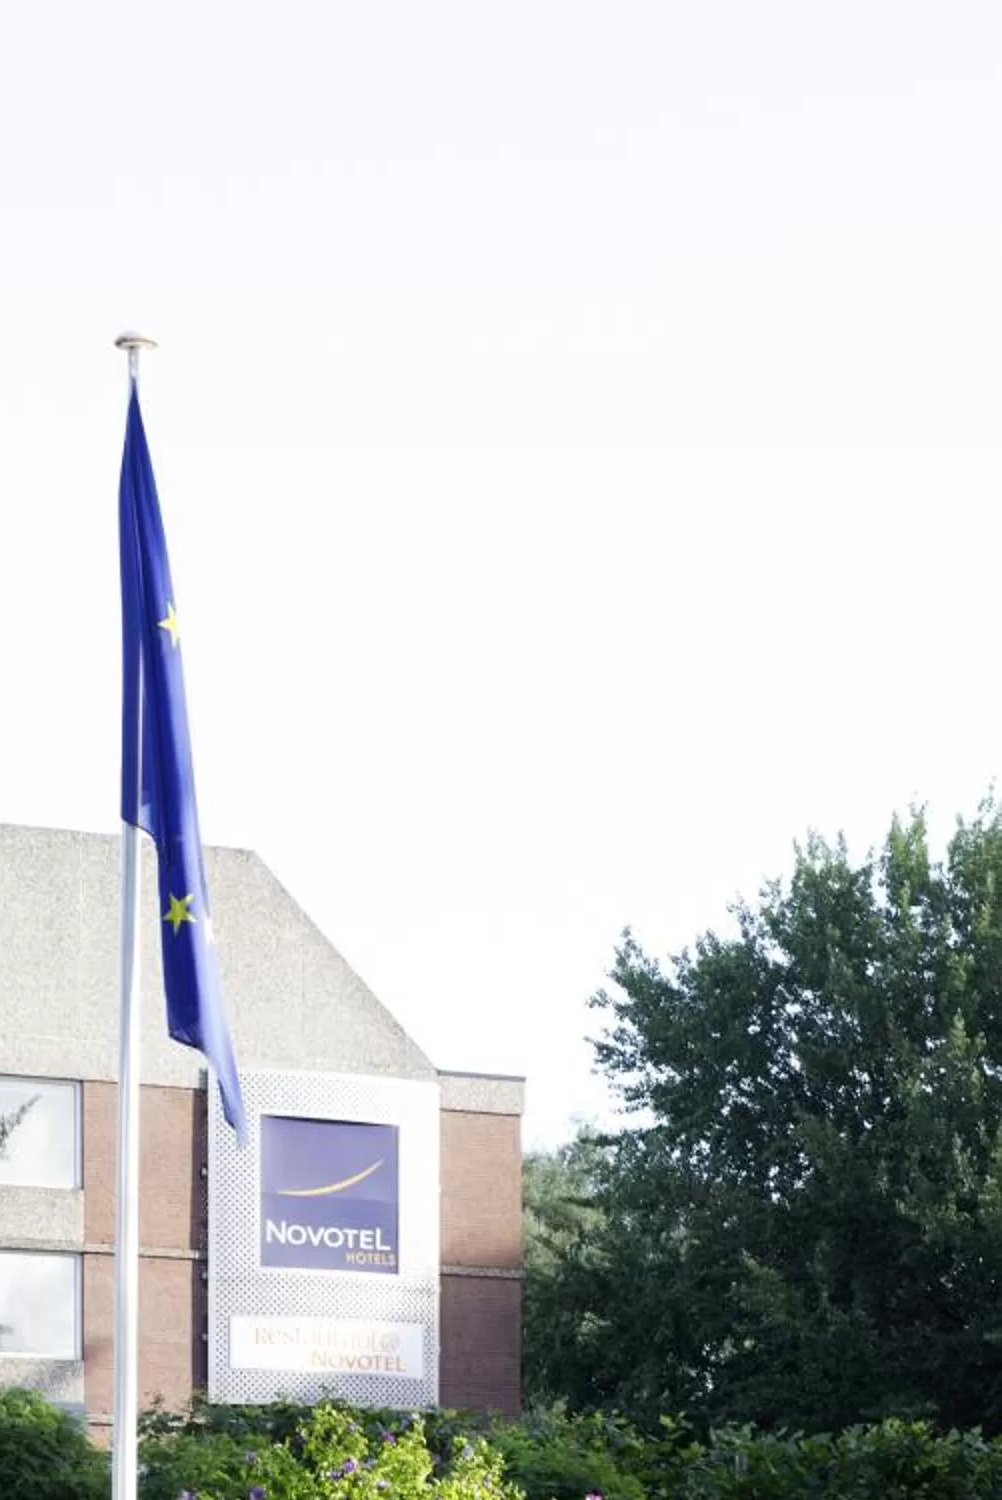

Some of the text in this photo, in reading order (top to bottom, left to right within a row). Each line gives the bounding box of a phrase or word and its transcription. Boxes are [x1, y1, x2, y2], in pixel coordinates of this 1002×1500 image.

[265, 1219, 391, 1251] NOVOTEL
[346, 1251, 397, 1266] HOTELS
[311, 1349, 407, 1373] NOVOTEL
